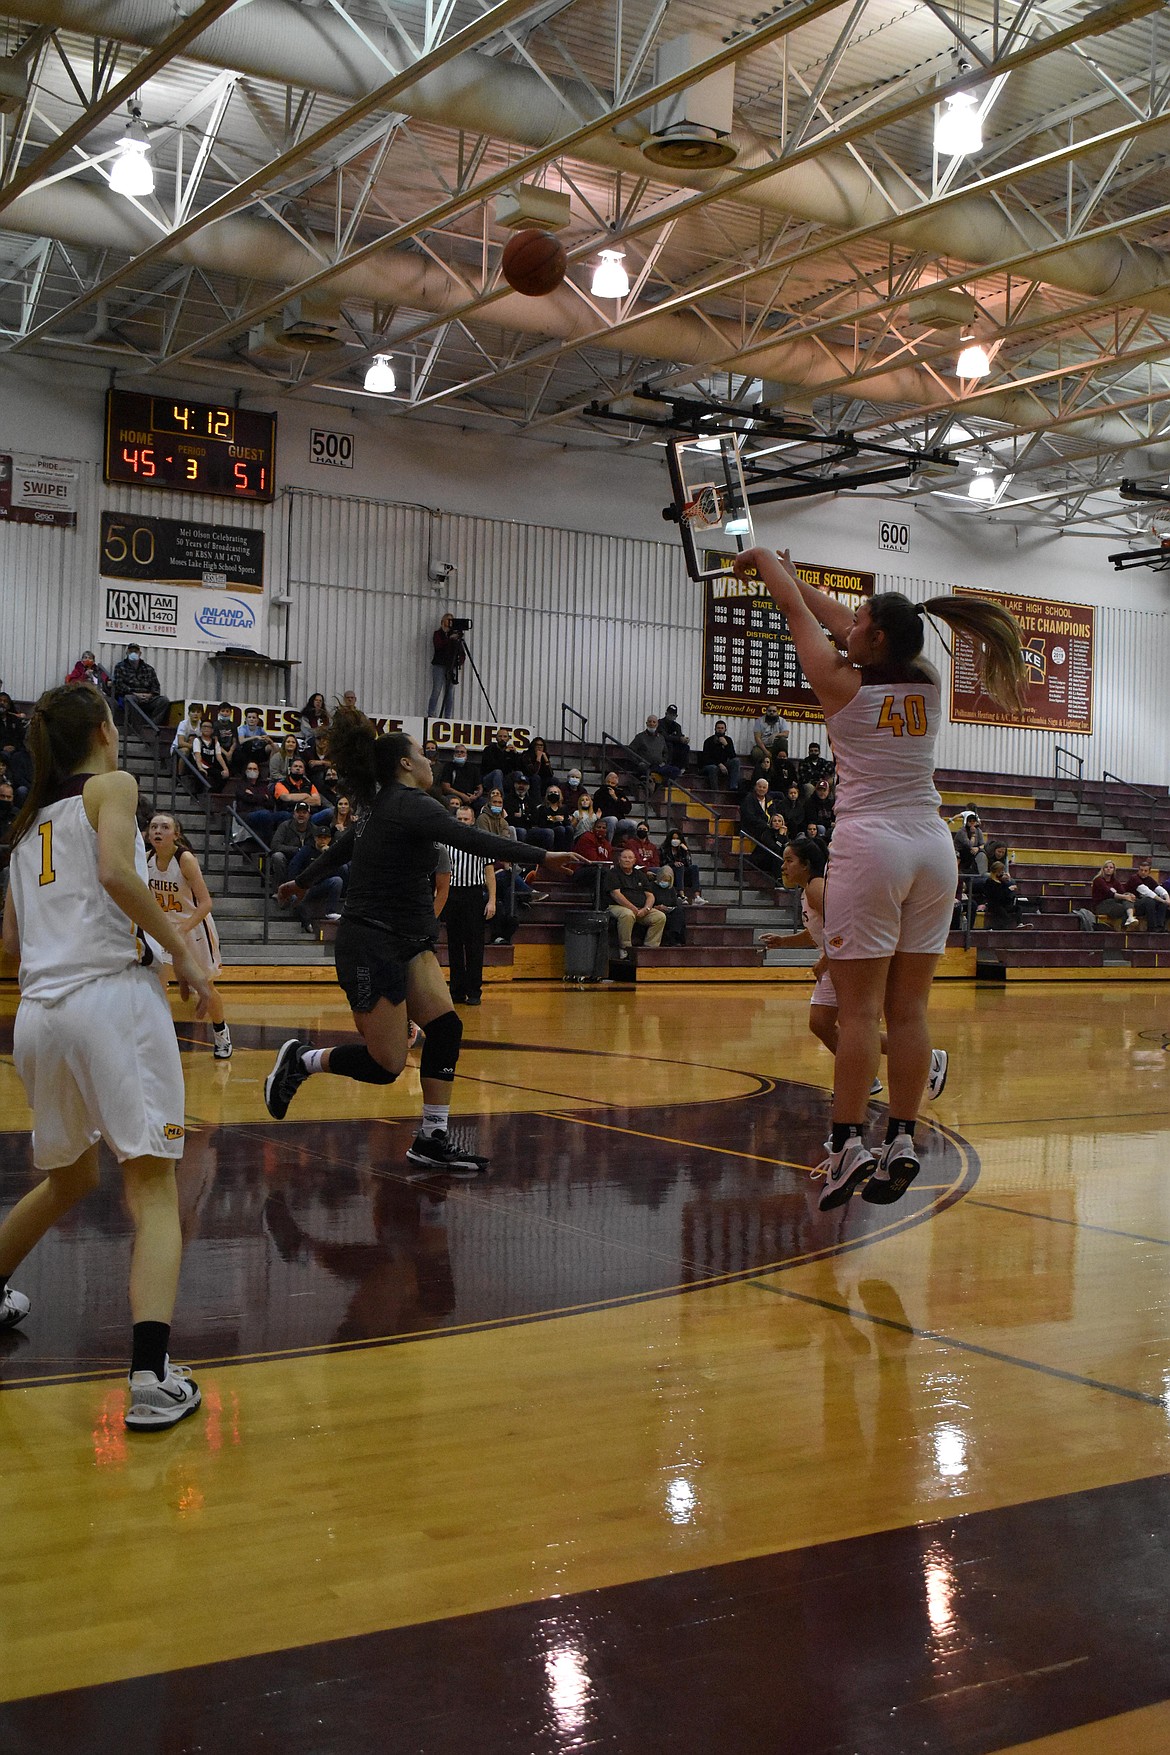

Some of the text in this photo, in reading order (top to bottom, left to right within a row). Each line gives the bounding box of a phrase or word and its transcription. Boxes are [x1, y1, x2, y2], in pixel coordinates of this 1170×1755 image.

[173, 406, 230, 438] 4:12
[119, 429, 154, 446] HOME
[312, 432, 351, 459] 500
[177, 444, 265, 462] PERIOD GUEST
[316, 457, 346, 466] HALL
[37, 461, 59, 470] PRIDE
[122, 448, 156, 477] 45
[186, 458, 198, 480] 3
[233, 462, 265, 490] 51
[23, 481, 67, 497] SWIPE!
[180, 528, 248, 546] Mel Olson Celebrating
[881, 523, 908, 545] 600
[104, 524, 155, 565] 50
[176, 538, 184, 546] 50
[185, 539, 202, 549] Years
[212, 542, 251, 556] Broadcasting
[169, 557, 256, 575] Moses Lake High School Sports
[214, 552, 225, 561] AM
[226, 554, 241, 563] 1470
[824, 572, 863, 591] SCHOOL
[108, 590, 172, 622] KBSN AM
[202, 607, 244, 619] INLAND
[752, 600, 773, 610] STATE
[1004, 600, 1023, 612] LAKE
[1025, 602, 1042, 614] HIGH
[1044, 606, 1072, 618] SCHOOL
[151, 612, 174, 622] 1470
[199, 615, 253, 629] CELLULAR
[1014, 614, 1091, 638] TATE CHAMPIONS
[106, 621, 176, 634] NEWS TALK SPORTS
[746, 630, 778, 640] DISTRICT
[712, 673, 726, 681] 2000
[731, 674, 744, 683] 2001
[712, 682, 724, 690] 2011
[705, 702, 745, 713] Sponsored
[746, 706, 756, 714] by
[876, 695, 928, 737] 40
[38, 820, 56, 886] 1
